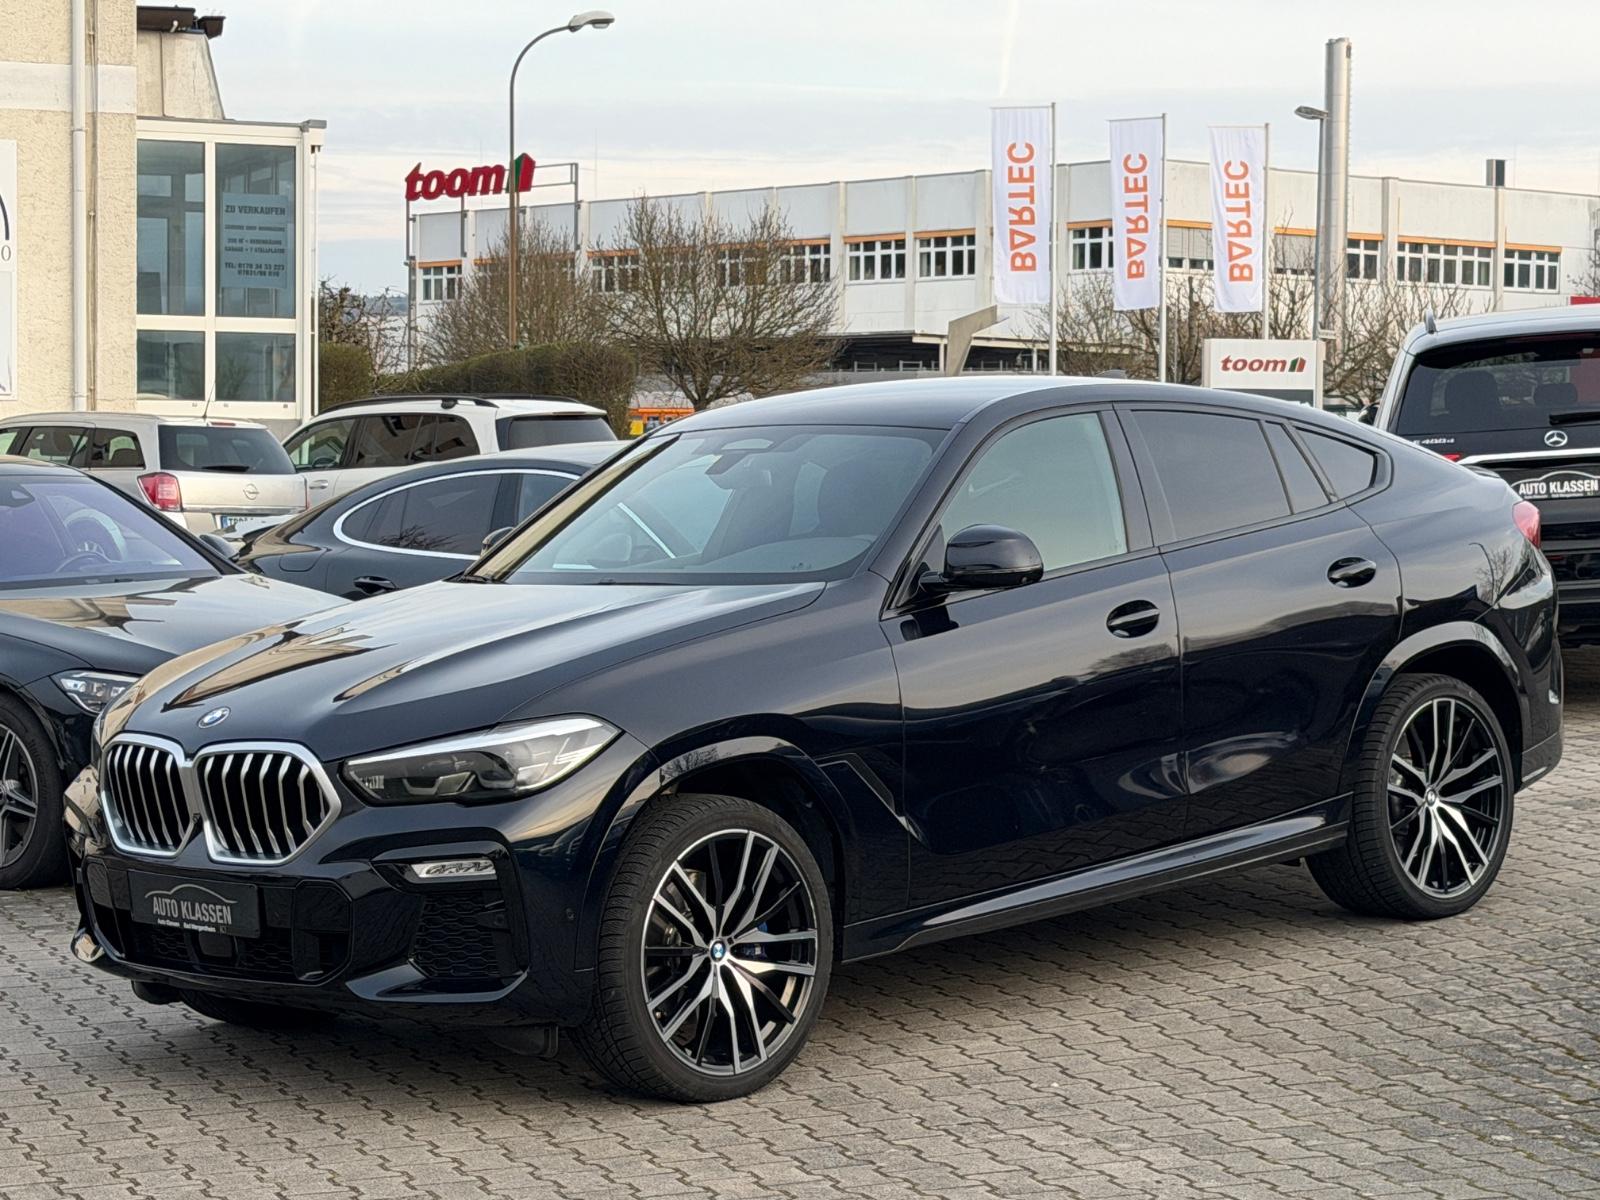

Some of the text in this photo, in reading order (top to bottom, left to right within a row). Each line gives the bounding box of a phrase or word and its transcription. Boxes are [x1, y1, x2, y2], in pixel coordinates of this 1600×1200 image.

[405, 162, 505, 201] toom
[224, 204, 286, 216] ZU VERKAUFEN
[1221, 355, 1287, 372] toom
[1519, 479, 1599, 495] AUTO KLASSEN
[153, 896, 232, 925] AUTO KLASSEN
